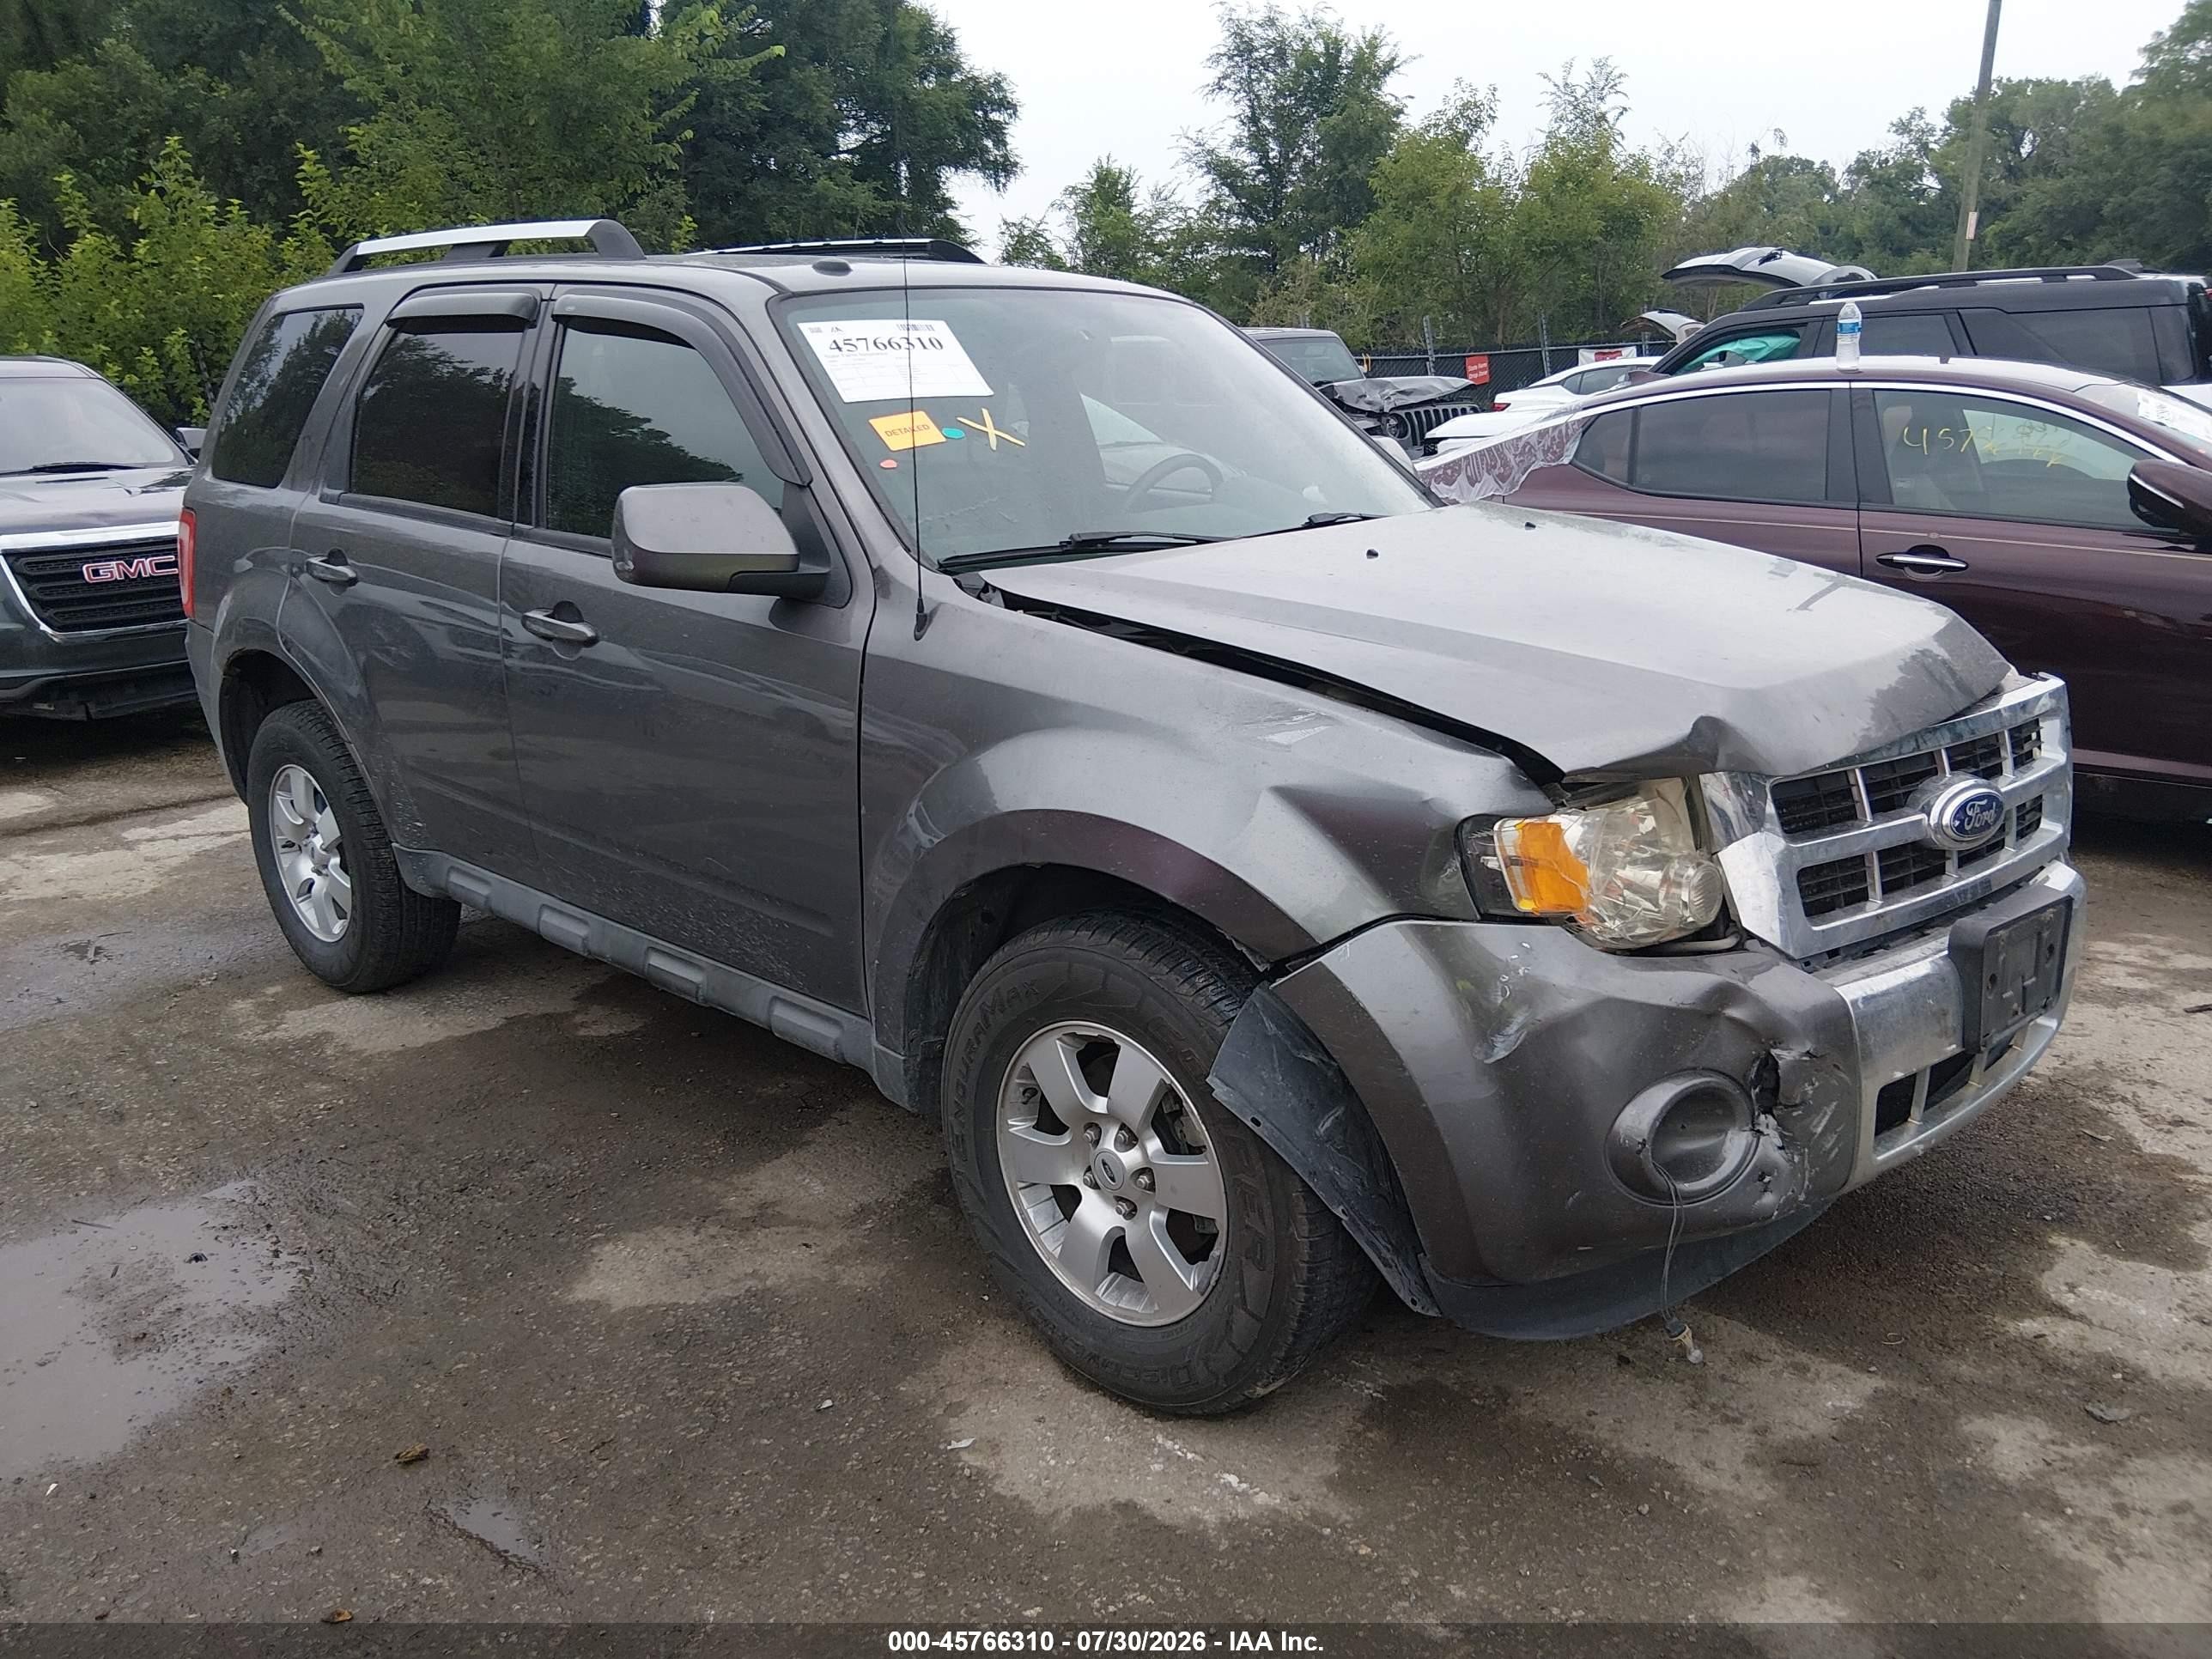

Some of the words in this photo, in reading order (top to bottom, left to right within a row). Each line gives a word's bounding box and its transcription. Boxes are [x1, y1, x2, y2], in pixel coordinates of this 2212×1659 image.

[829, 336, 944, 352] 45766310
[884, 424, 930, 437] DETAILED
[82, 555, 179, 584] GMC
[1964, 799, 1996, 831] Ford
